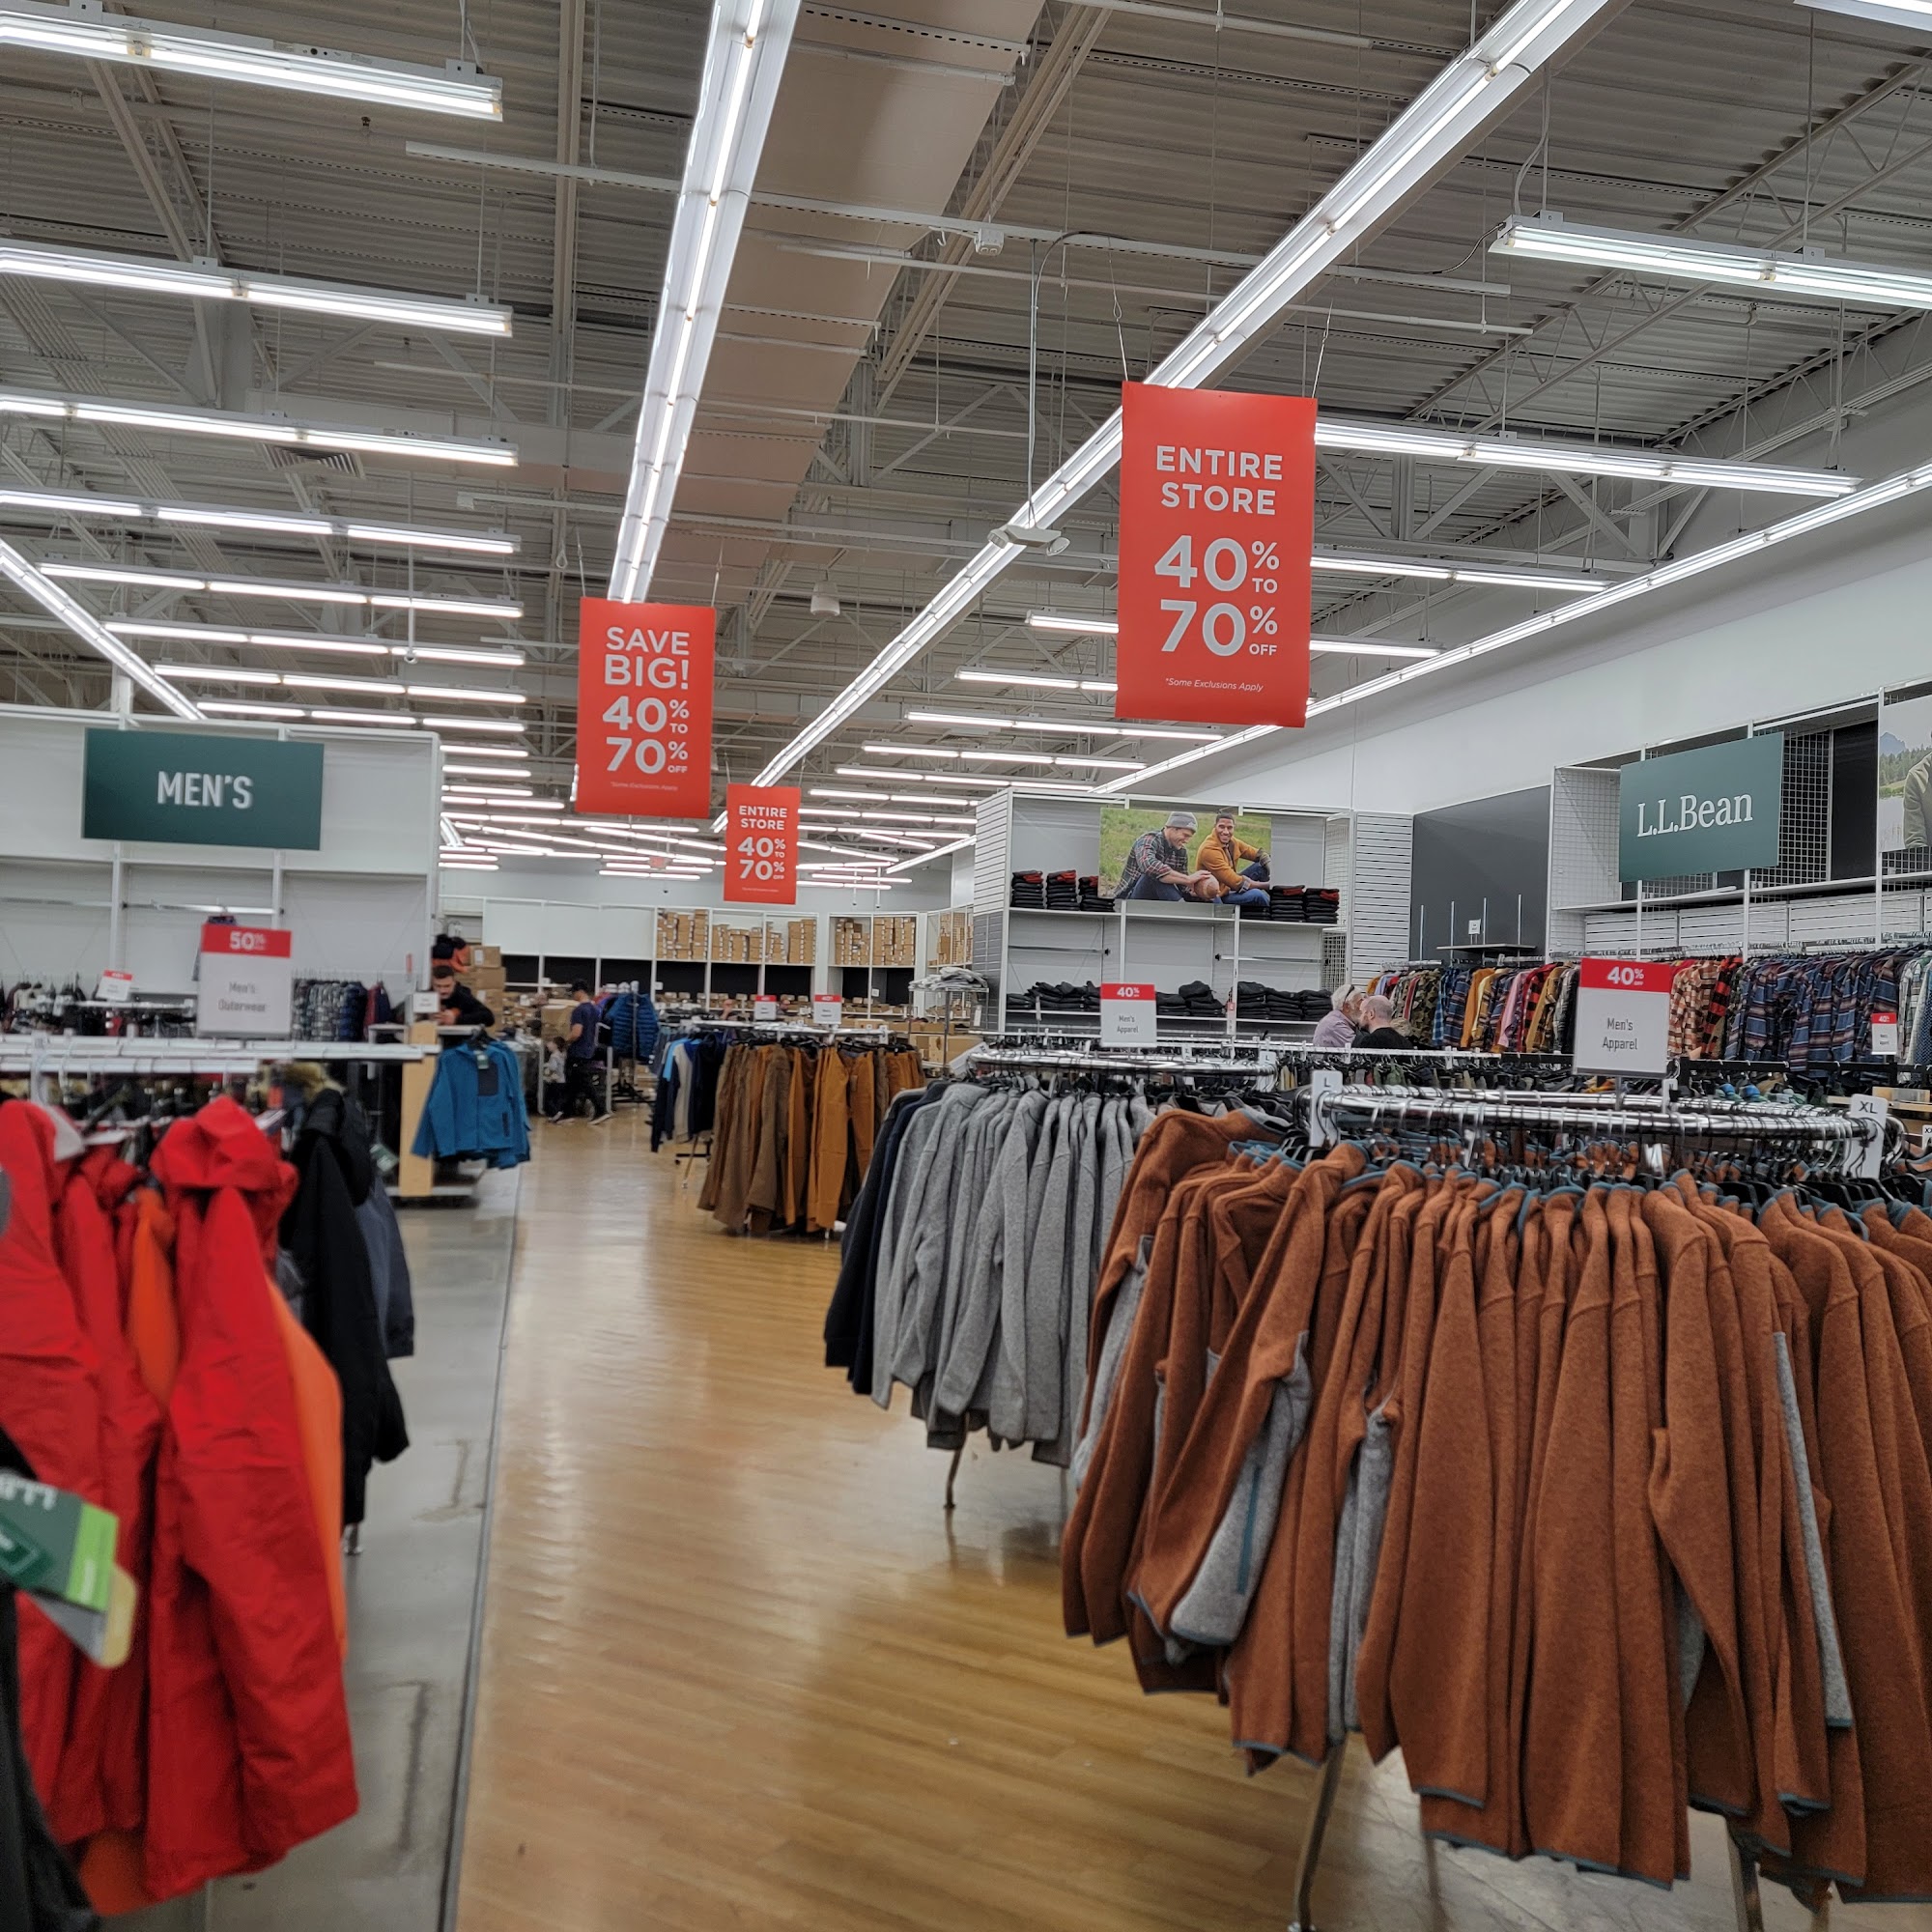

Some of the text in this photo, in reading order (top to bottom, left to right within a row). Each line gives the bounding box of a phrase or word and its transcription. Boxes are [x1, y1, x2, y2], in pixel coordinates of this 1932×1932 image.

[1156, 445, 1283, 480] ENTIRE
[1161, 481, 1276, 515] STORE
[1252, 577, 1278, 594] TO
[606, 626, 690, 656] SAVE
[1249, 643, 1277, 656] OFF
[604, 653, 690, 690] BIG!
[1194, 679, 1236, 690] Exclusions
[1238, 682, 1264, 693] Apply
[669, 723, 689, 734] TO
[668, 765, 688, 774] OFF
[157, 771, 254, 810] MEN'S
[738, 805, 788, 818] ENTIRE
[1636, 794, 1754, 838] L.L.Bean
[740, 818, 785, 831] STORE
[1117, 1025, 1139, 1034] Apparel
[1606, 1017, 1634, 1031] Men's
[1602, 1037, 1638, 1053] Apparel
[1323, 1077, 1331, 1088] L
[1859, 1100, 1879, 1115] XL
